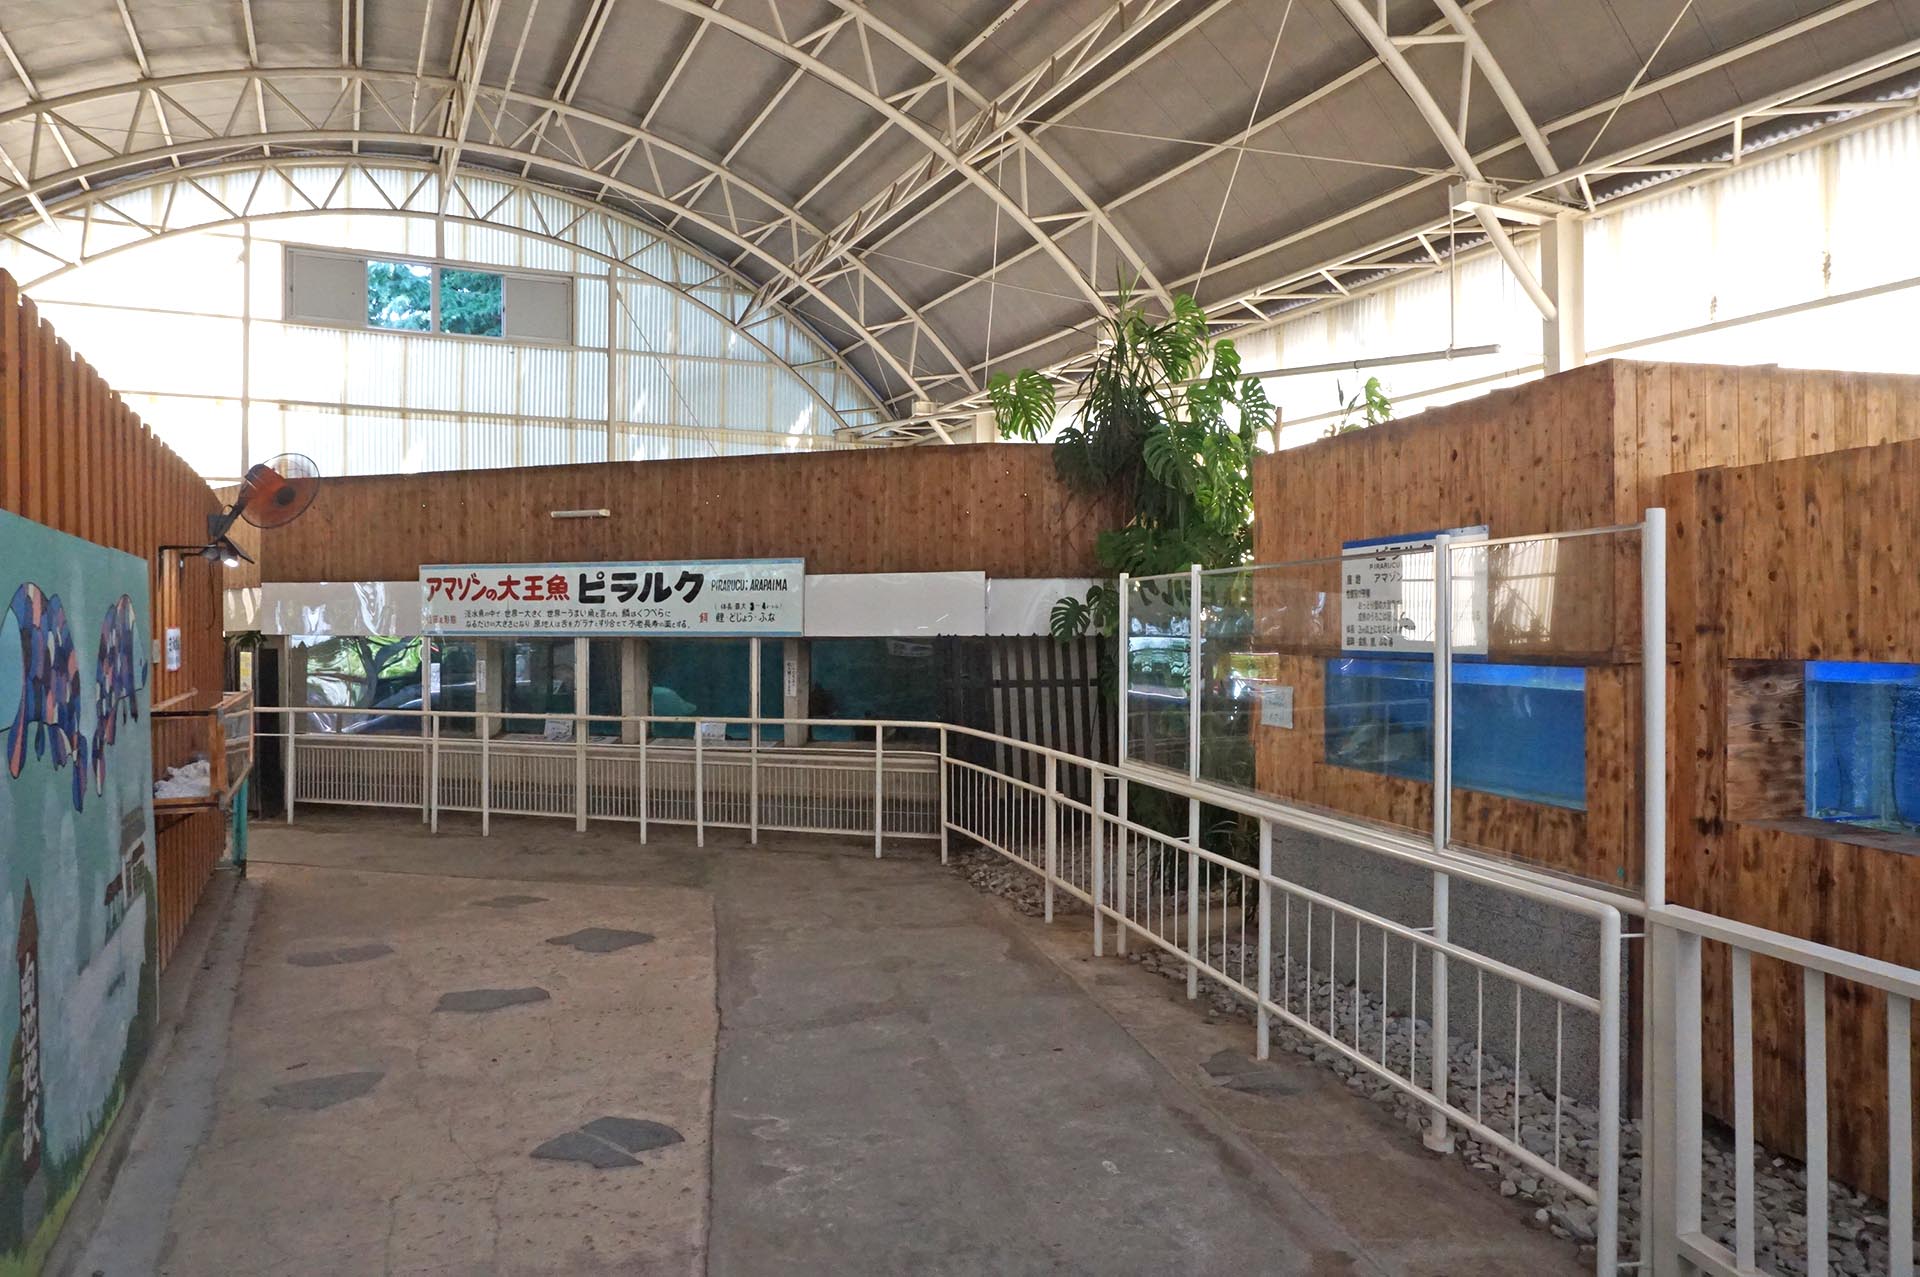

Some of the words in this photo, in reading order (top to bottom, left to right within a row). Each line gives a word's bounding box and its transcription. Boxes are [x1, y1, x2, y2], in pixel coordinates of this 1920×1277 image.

[1374, 572, 1403, 583] アマゾン
[426, 573, 570, 602] アマゾンの大王魚
[579, 571, 704, 603] ピラルク
[750, 578, 788, 591] ARAPAIMA
